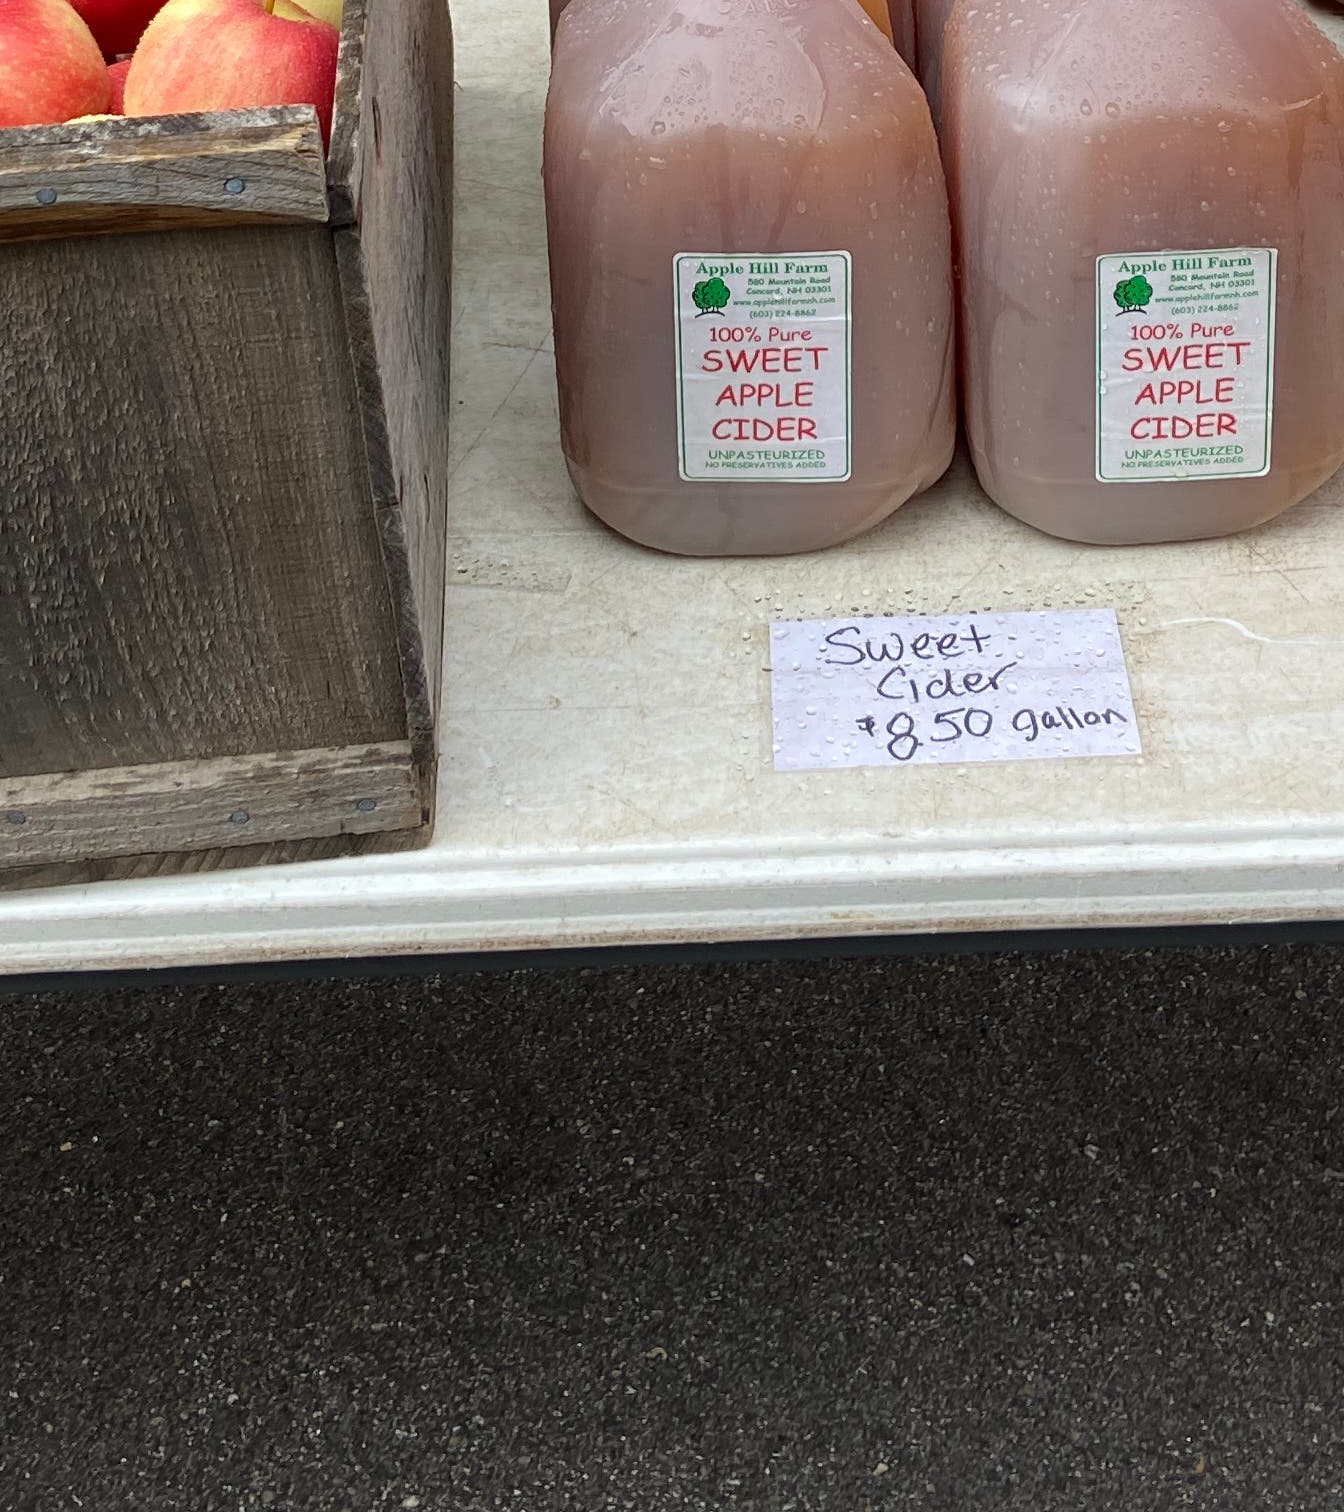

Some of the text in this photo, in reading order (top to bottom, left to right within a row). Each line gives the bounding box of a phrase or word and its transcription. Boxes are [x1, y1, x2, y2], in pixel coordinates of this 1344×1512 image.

[696, 262, 828, 277] Apple Hill Farm
[1118, 256, 1253, 275] Apple Hill Farm
[809, 276, 831, 284] Road
[1191, 272, 1230, 281] Mountain
[1233, 269, 1255, 277] Road
[805, 285, 832, 294] 03301
[1210, 281, 1225, 289] NH
[1227, 279, 1255, 288] 03301
[749, 310, 773, 319] (603)
[1171, 306, 1196, 316] (603)
[709, 326, 813, 343] 100% Pure
[1131, 322, 1235, 341] 100% Pure
[701, 347, 829, 373] SWEET
[1121, 341, 1251, 372] SWEET
[715, 381, 814, 407] APPLE
[1134, 377, 1235, 406] APPLE
[712, 417, 818, 441] CIDER
[1130, 412, 1237, 440] CIDER
[708, 449, 825, 460] UNPASTEURIZED
[1124, 444, 1244, 460] UNPASTEURIZED
[705, 461, 826, 469] NO PRESERVATIVES ADDED
[1137, 458, 1211, 467] PRESERVATIVES
[1213, 456, 1244, 464] ADDED
[824, 624, 991, 666] Sweet
[876, 661, 1018, 703] Cider
[1012, 706, 1127, 742] gallon
